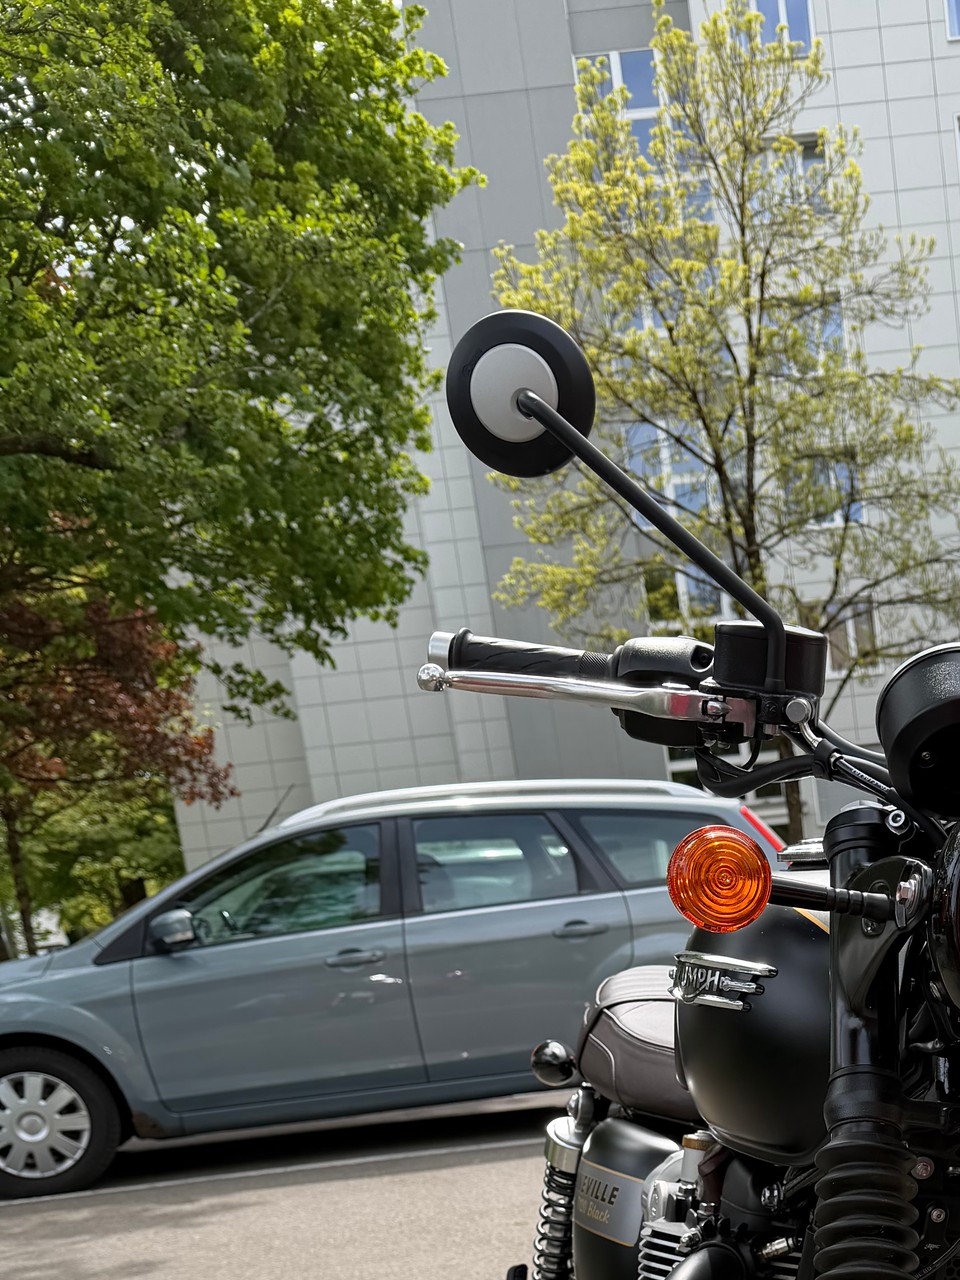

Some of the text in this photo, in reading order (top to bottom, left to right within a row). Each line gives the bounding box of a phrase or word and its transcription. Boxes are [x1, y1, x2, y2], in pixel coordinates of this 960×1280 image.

[681, 966, 720, 992] UMPH
[580, 1175, 620, 1206] EVILLE
[587, 1201, 610, 1224] Black
